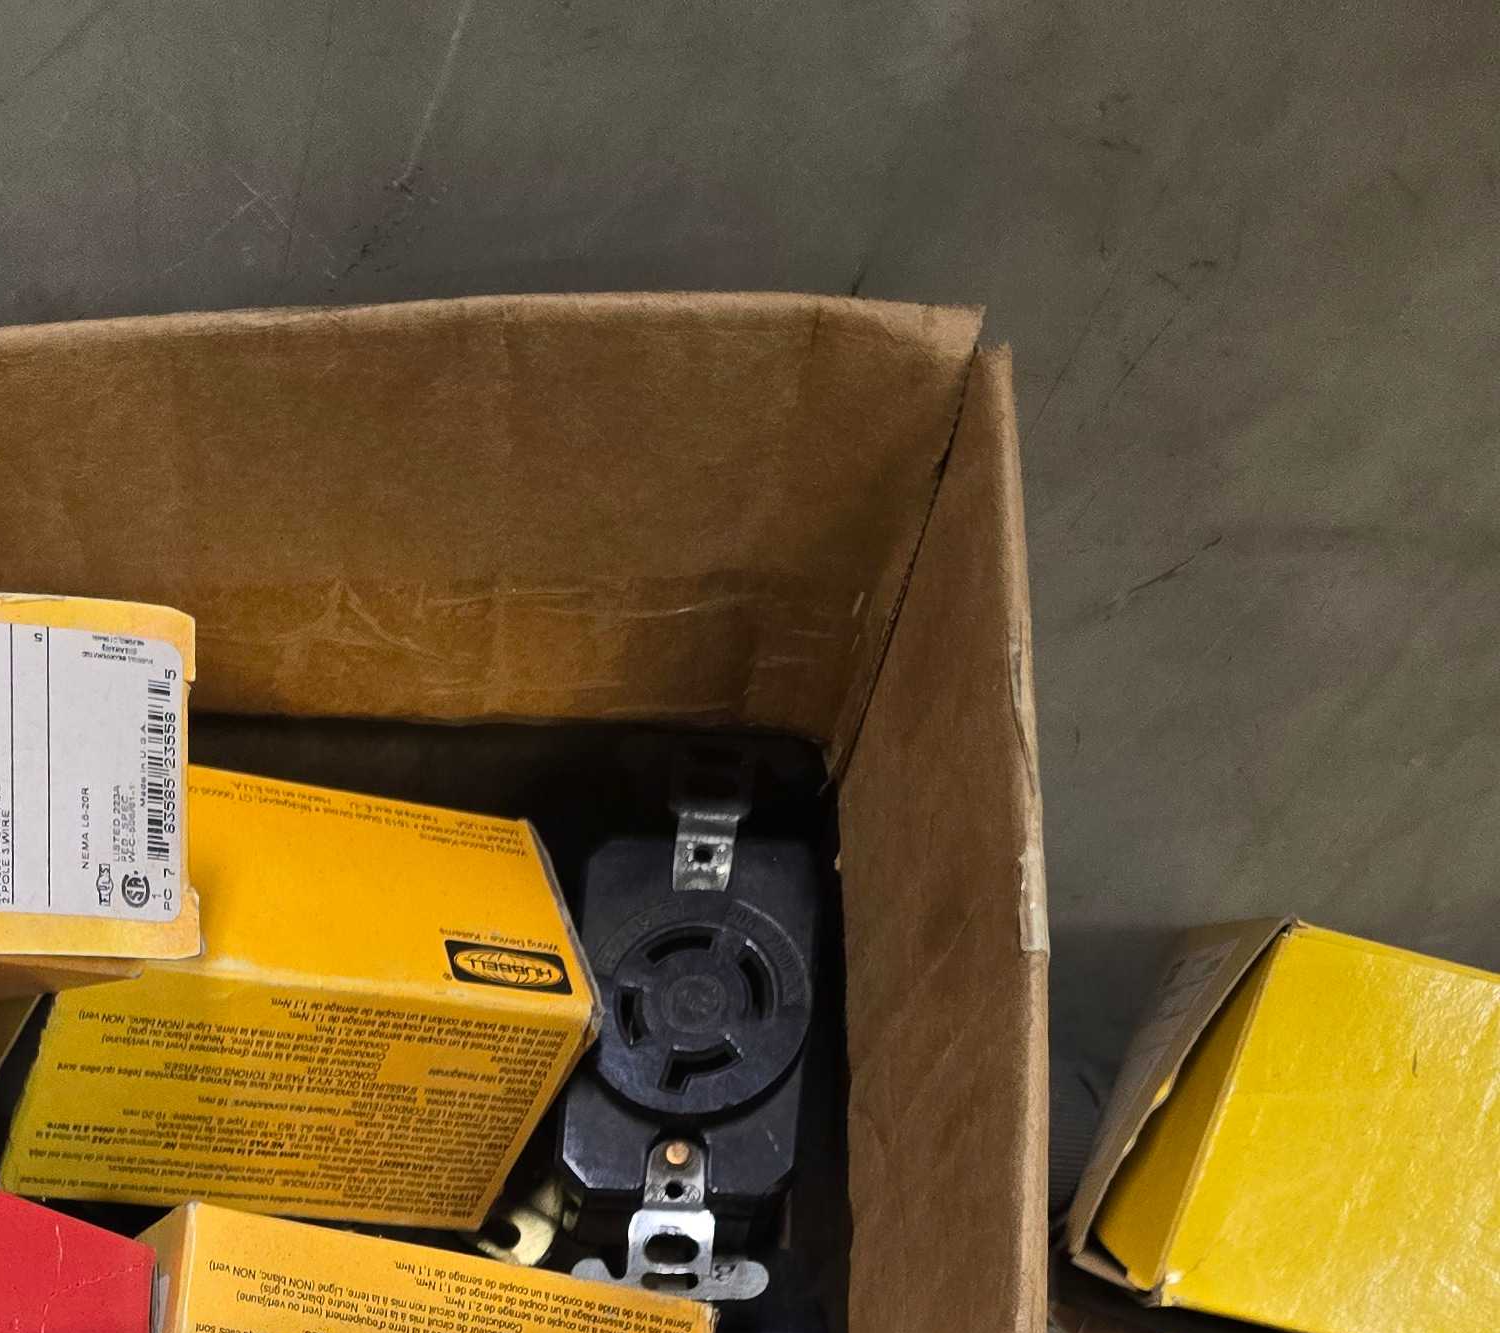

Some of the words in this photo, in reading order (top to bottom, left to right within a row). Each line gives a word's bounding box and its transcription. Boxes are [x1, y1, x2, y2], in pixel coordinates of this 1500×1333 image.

[164, 712, 175, 768] 23558
[164, 778, 175, 834] 83585
[81, 832, 89, 869] NEMA
[470, 958, 553, 978] HUBBELL
